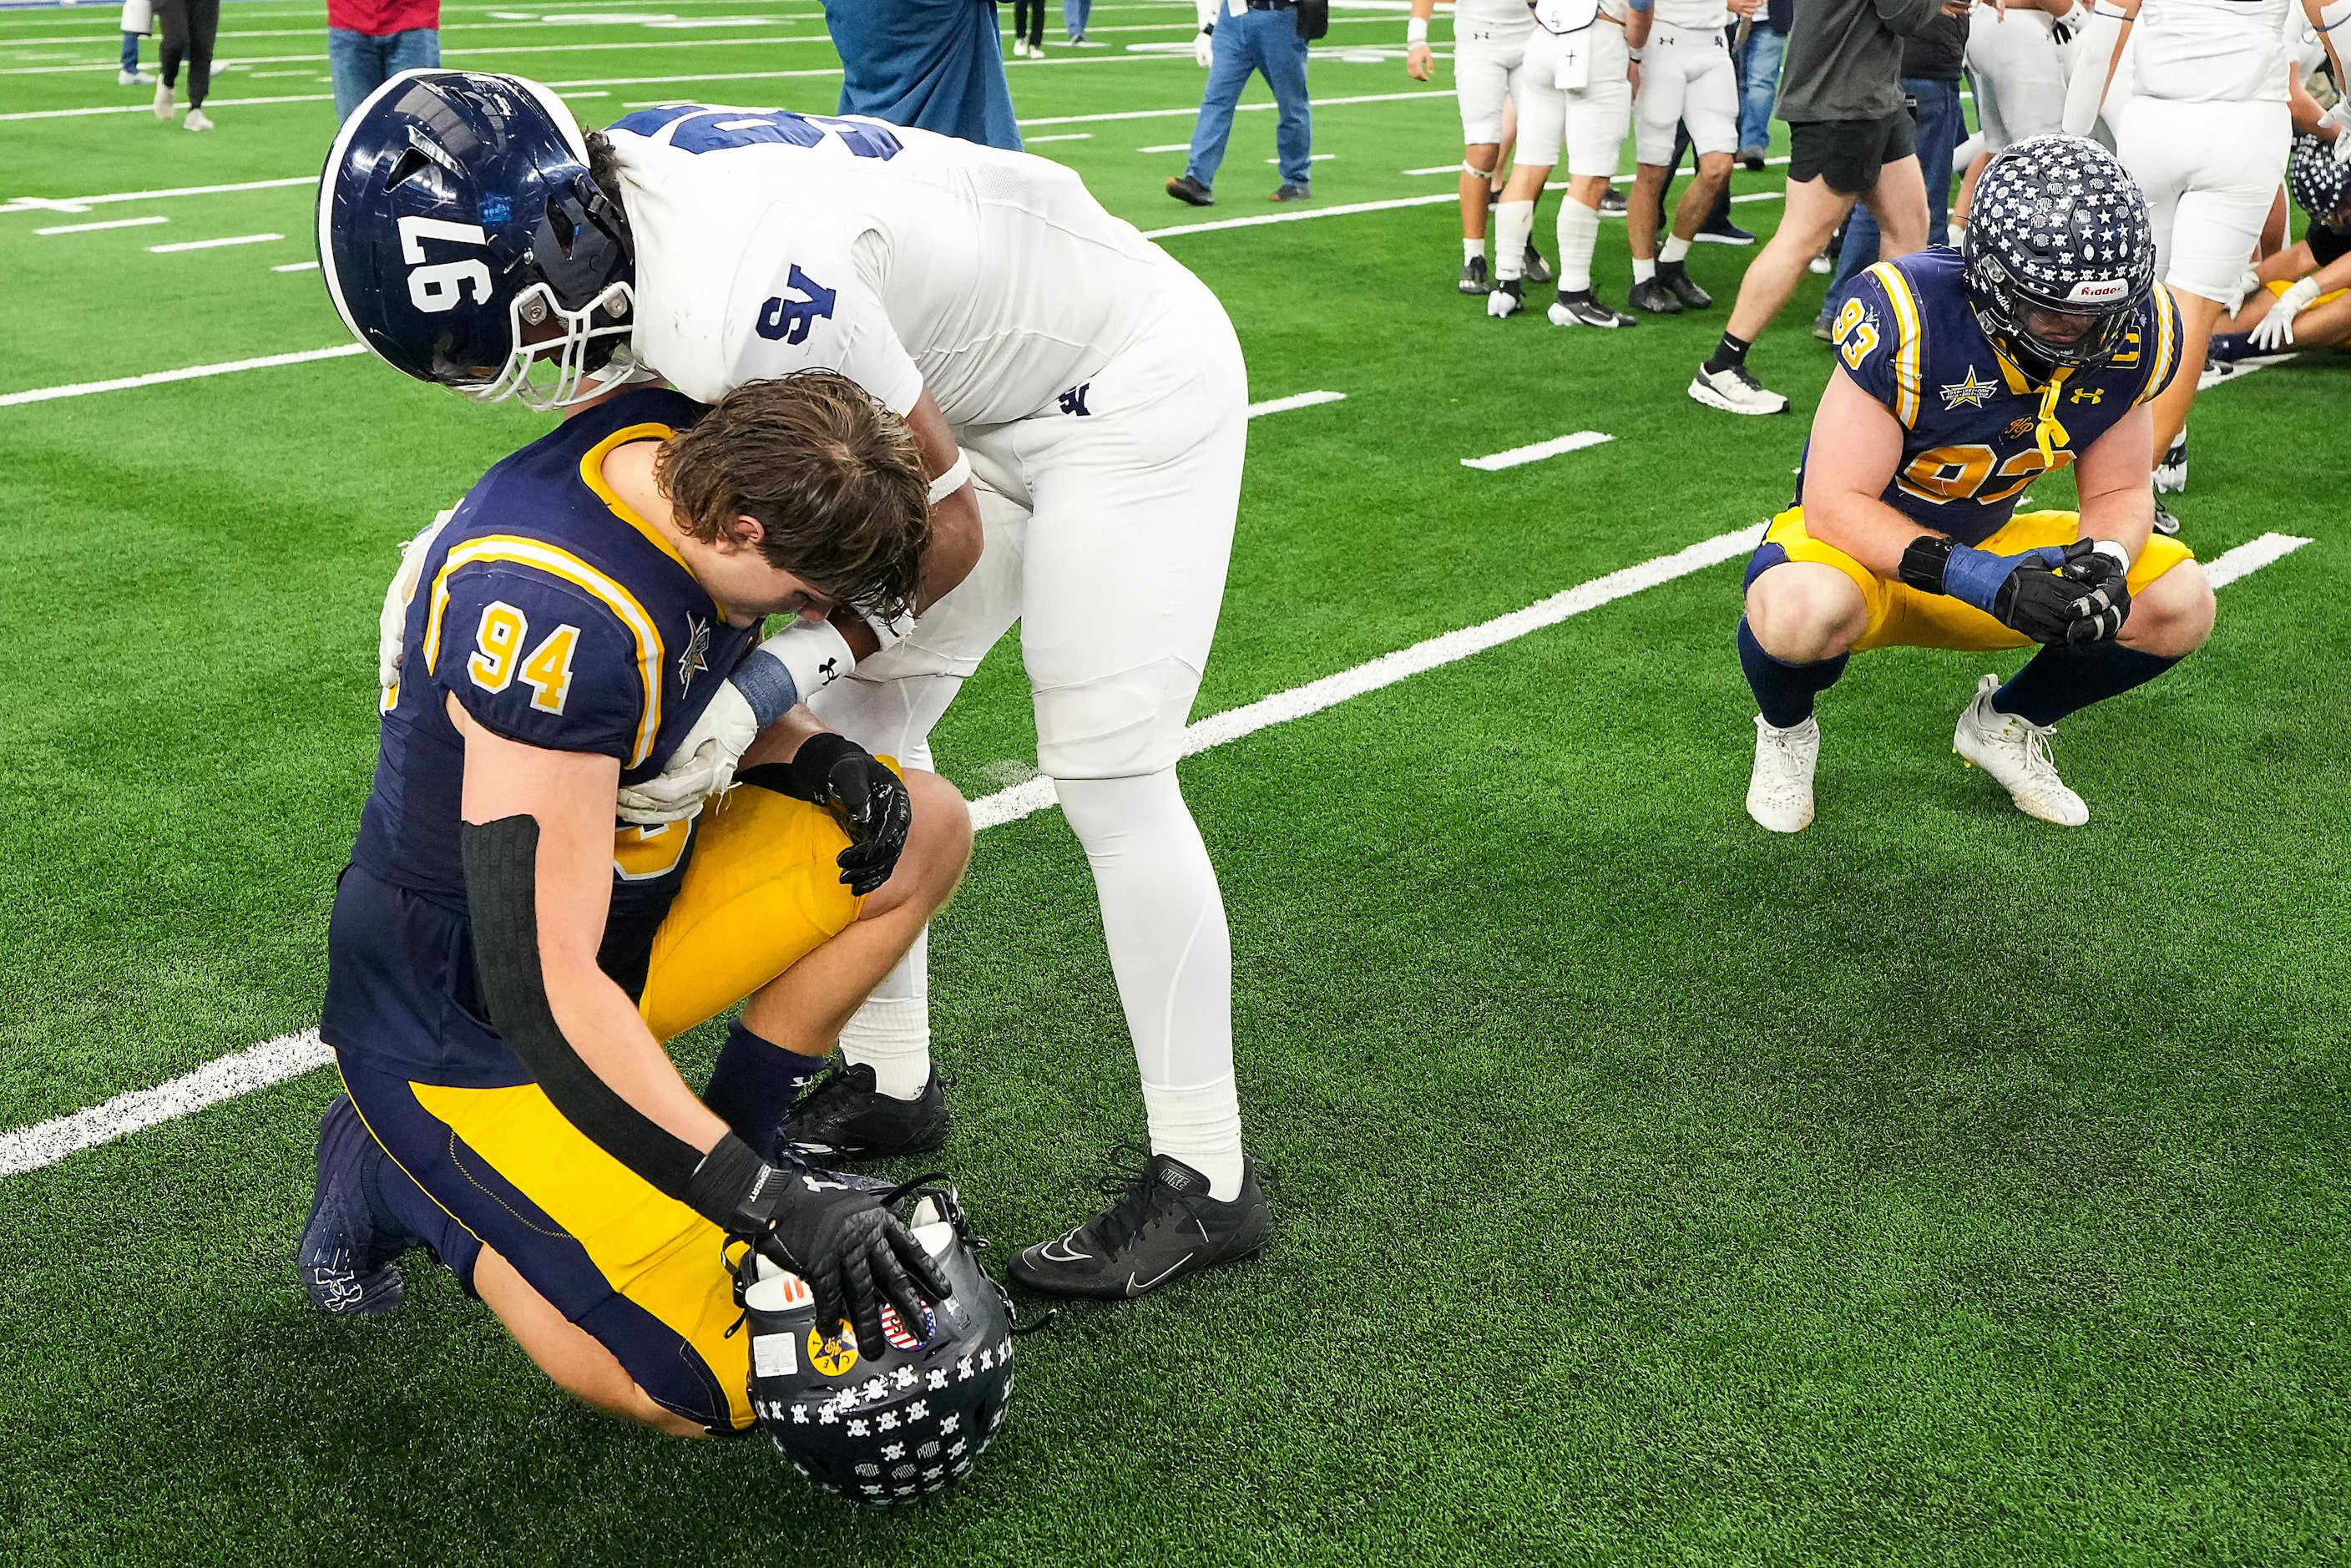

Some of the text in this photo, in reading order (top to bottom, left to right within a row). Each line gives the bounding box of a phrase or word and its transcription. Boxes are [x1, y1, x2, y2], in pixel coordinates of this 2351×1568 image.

[2047, 183, 2065, 195] PRIDE
[2037, 197, 2053, 212] PRIDE
[2030, 214, 2046, 228] PRIDE
[2075, 210, 2091, 224] PRIDE
[2033, 233, 2050, 247] PRIDE
[397, 215, 493, 313] 97
[1994, 285, 2010, 314] Ridde
[2081, 286, 2123, 296] Ridde
[756, 263, 837, 345] SV
[1833, 297, 1880, 370] 93
[467, 600, 583, 716] 94
[749, 1164, 771, 1202] COMBAT
[1159, 1168, 1191, 1191] NIKE
[917, 1441, 941, 1459] PRIDE
[854, 1463, 881, 1478] PRIDE
[891, 1464, 917, 1480] PRIDE
